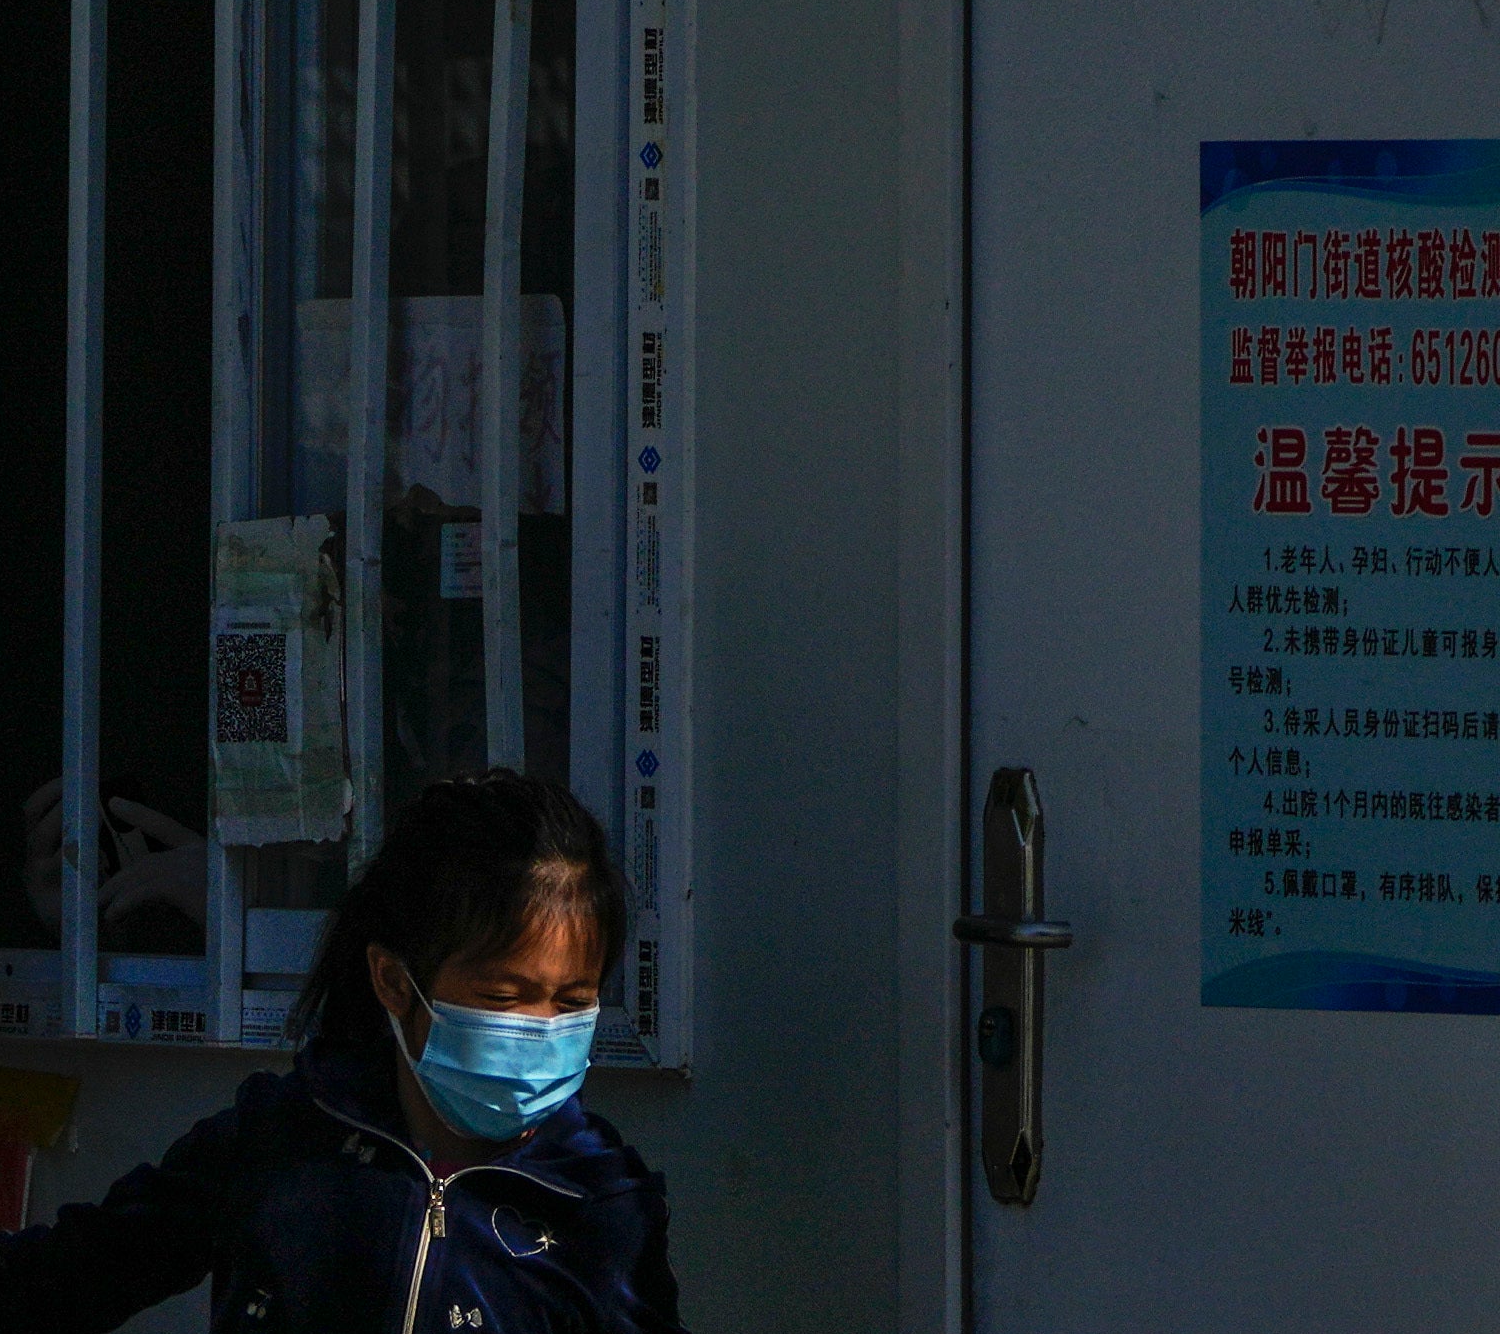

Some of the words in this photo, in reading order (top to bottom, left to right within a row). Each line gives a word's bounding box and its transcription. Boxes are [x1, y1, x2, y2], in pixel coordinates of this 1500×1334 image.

[643, 28, 658, 124] 津德型材
[1230, 228, 1500, 300] 朝阳门街道核酸检测
[642, 332, 656, 429] 津德型材
[1254, 426, 1500, 516] 温馨提示
[1264, 626, 1499, 661] 2.未携带身份证儿童可报身
[640, 636, 654, 733] 津德型材
[1264, 709, 1499, 741] 3.待采人员身份证扫码后请
[151, 1009, 205, 1031] 津德型材
[638, 941, 652, 1037] 津德型材
[175, 1033, 205, 1041] PROFIL
